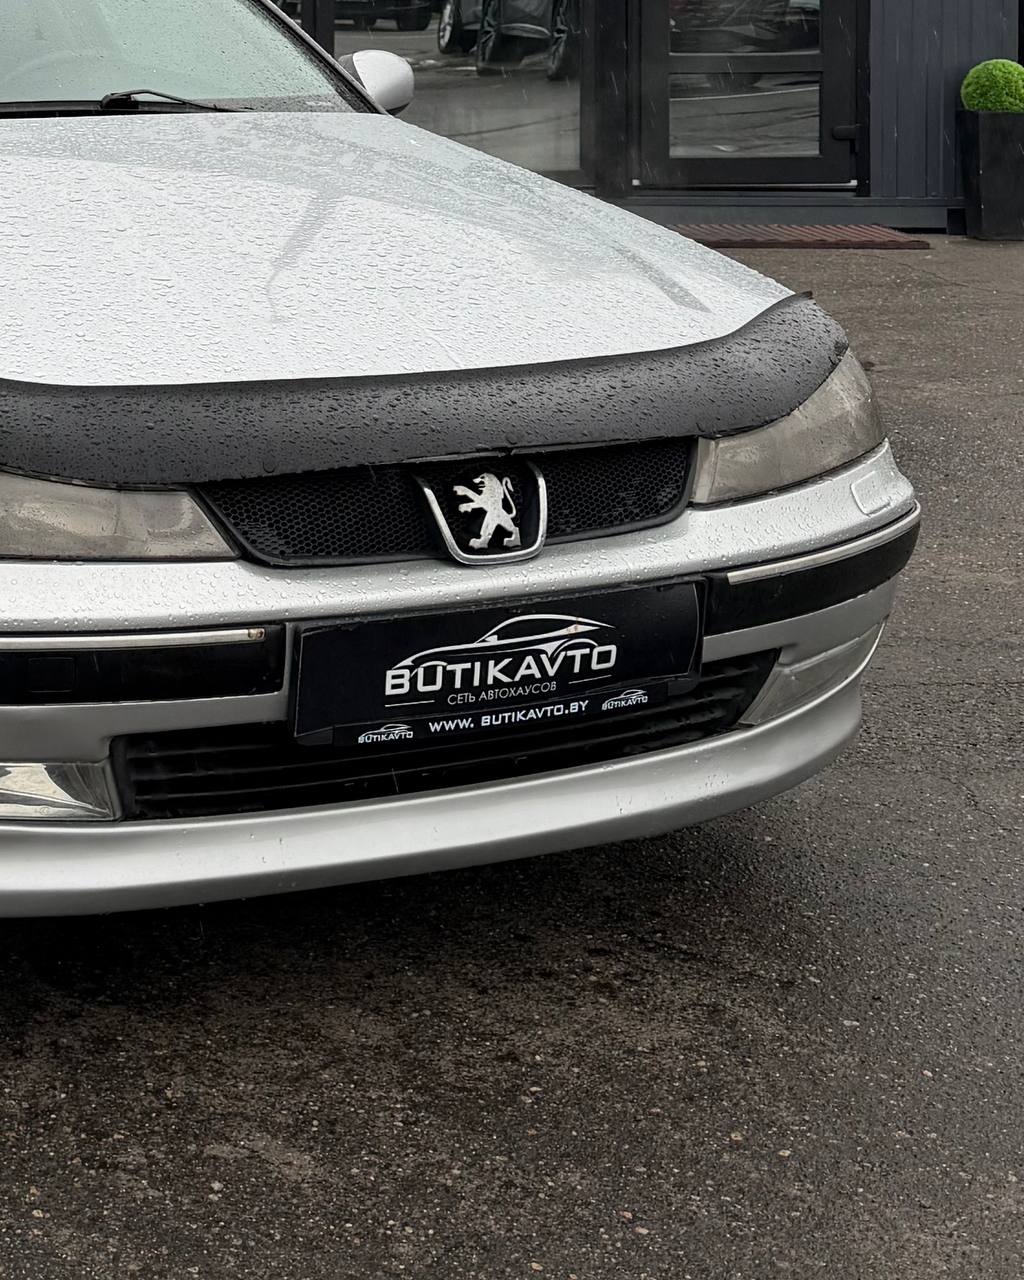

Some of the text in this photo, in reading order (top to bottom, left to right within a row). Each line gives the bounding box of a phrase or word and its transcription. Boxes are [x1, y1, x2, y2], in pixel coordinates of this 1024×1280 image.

[385, 644, 617, 696] BUTIKAVTO
[447, 681, 557, 706] СЕТЬ АВТОХАУСОВ
[601, 696, 648, 711] BUTIKAVTO
[429, 700, 589, 732] WWW. BUTIKAVTO.BY
[358, 731, 414, 744] BUTIKAVTO
